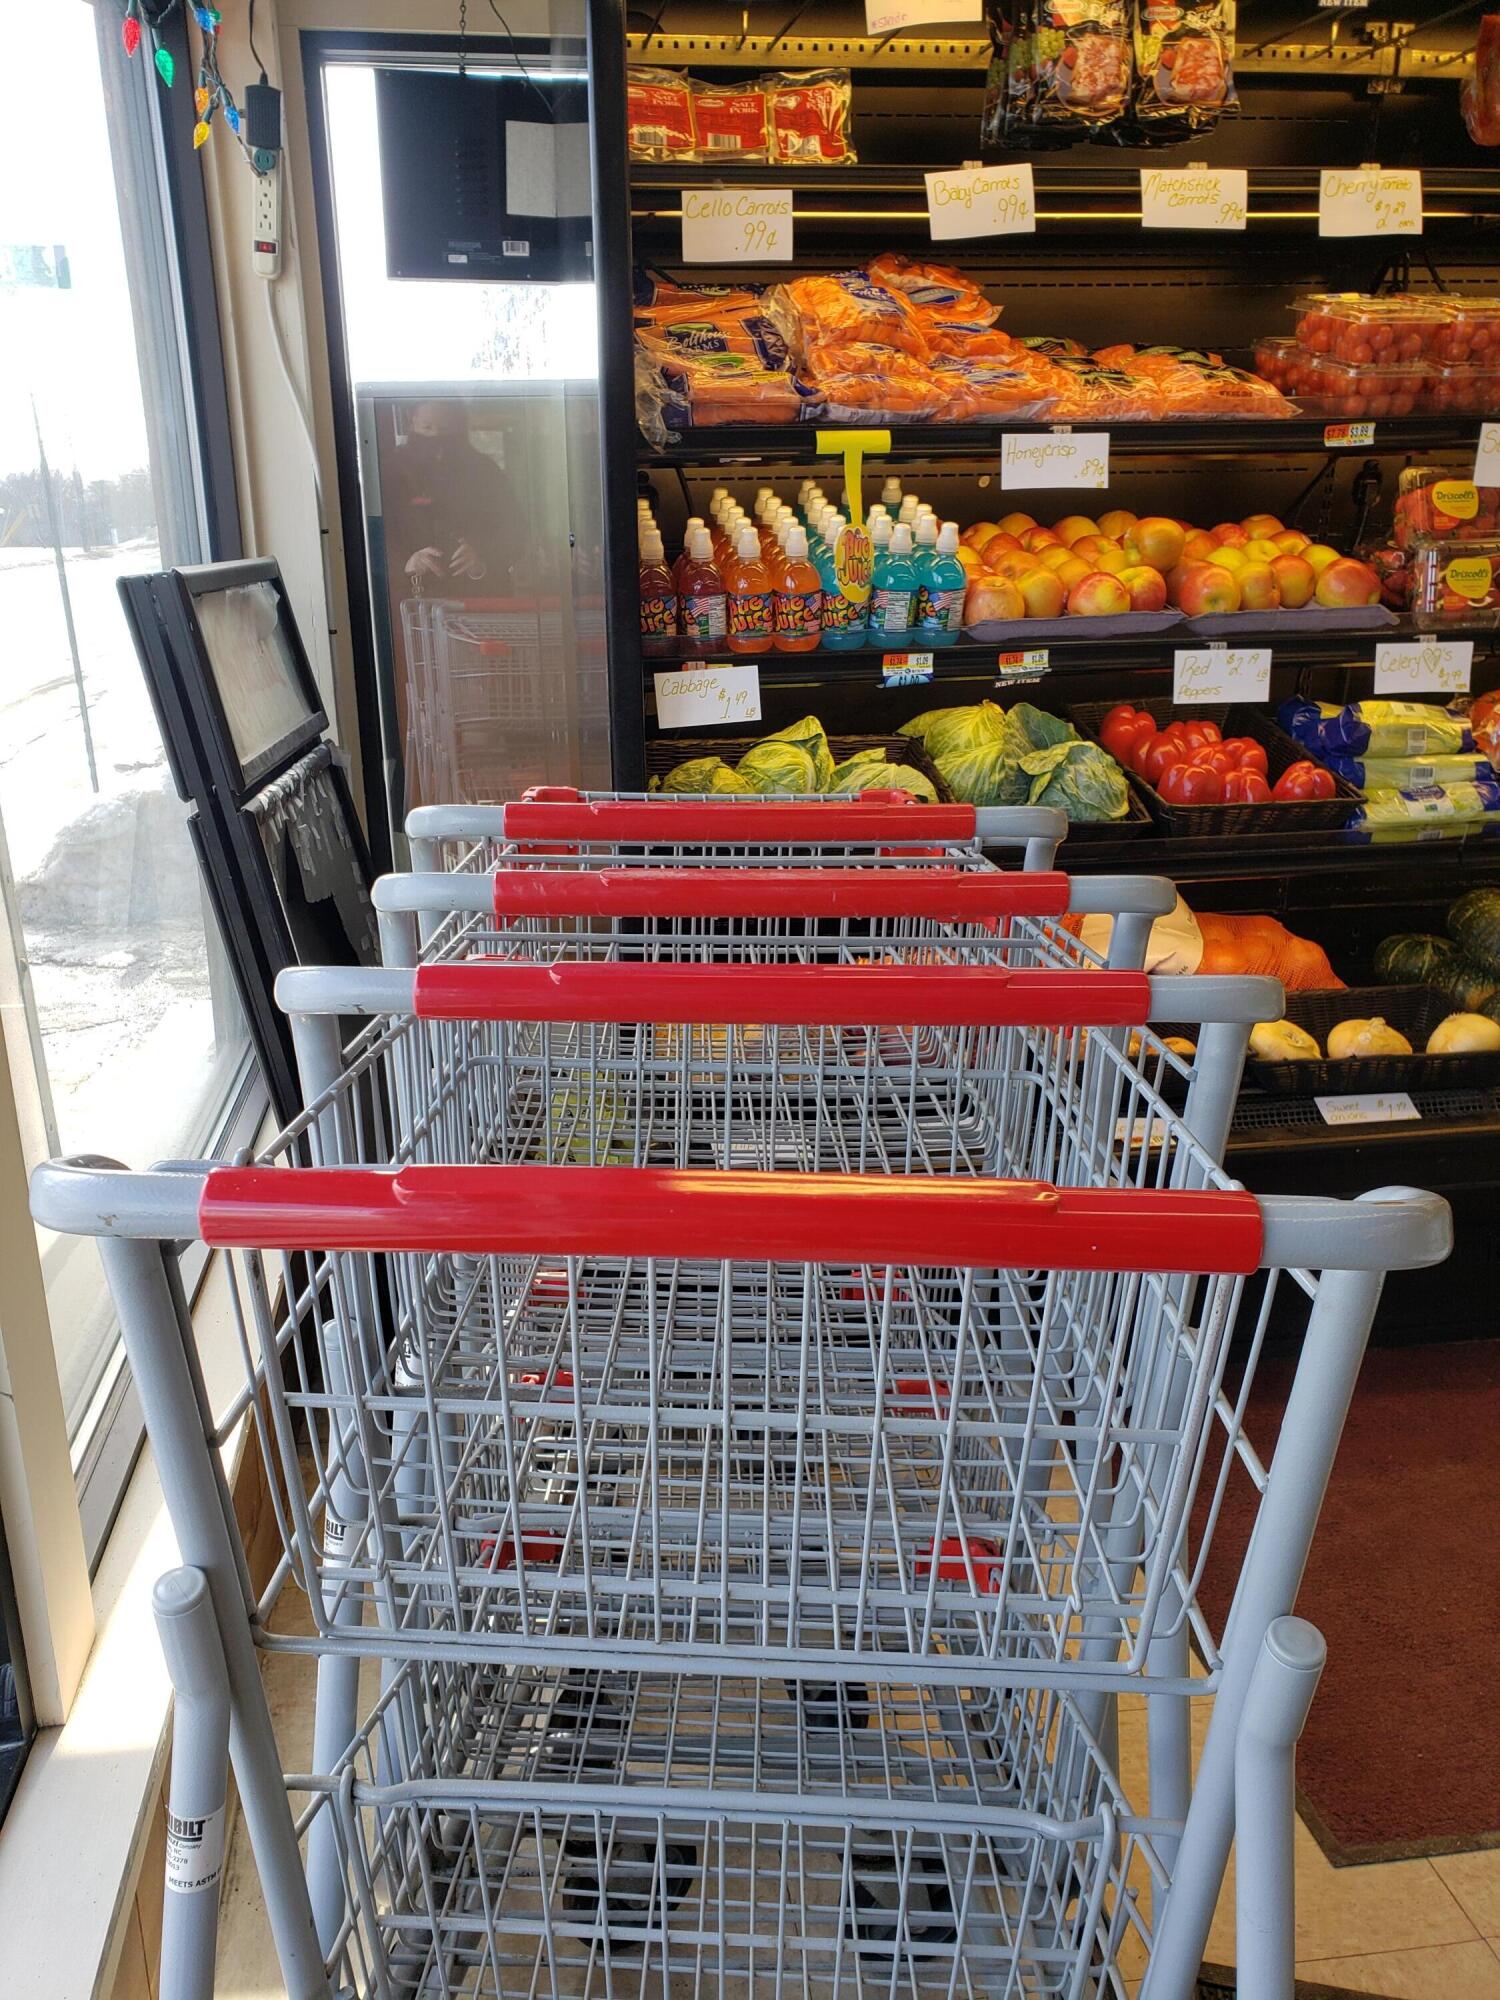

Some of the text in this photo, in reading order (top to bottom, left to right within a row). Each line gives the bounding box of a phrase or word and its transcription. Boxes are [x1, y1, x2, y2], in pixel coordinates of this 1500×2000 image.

[934, 177, 1019, 208] Baby Carrots
[1144, 172, 1221, 200] Matchstick
[1324, 174, 1378, 203] Cherry
[686, 194, 790, 219] Cello Carrots
[1168, 193, 1220, 207] Carrots
[1006, 437, 1078, 469] Honeycrisp
[1436, 490, 1475, 501] Driscoll's
[1450, 568, 1489, 580] Driscoll's
[1180, 656, 1212, 684] Red
[1380, 650, 1421, 678] Celery
[661, 678, 721, 699] Cabbage
[994, 679, 1014, 688] NEW
[168, 1871, 217, 1888] MEETS ASTM
